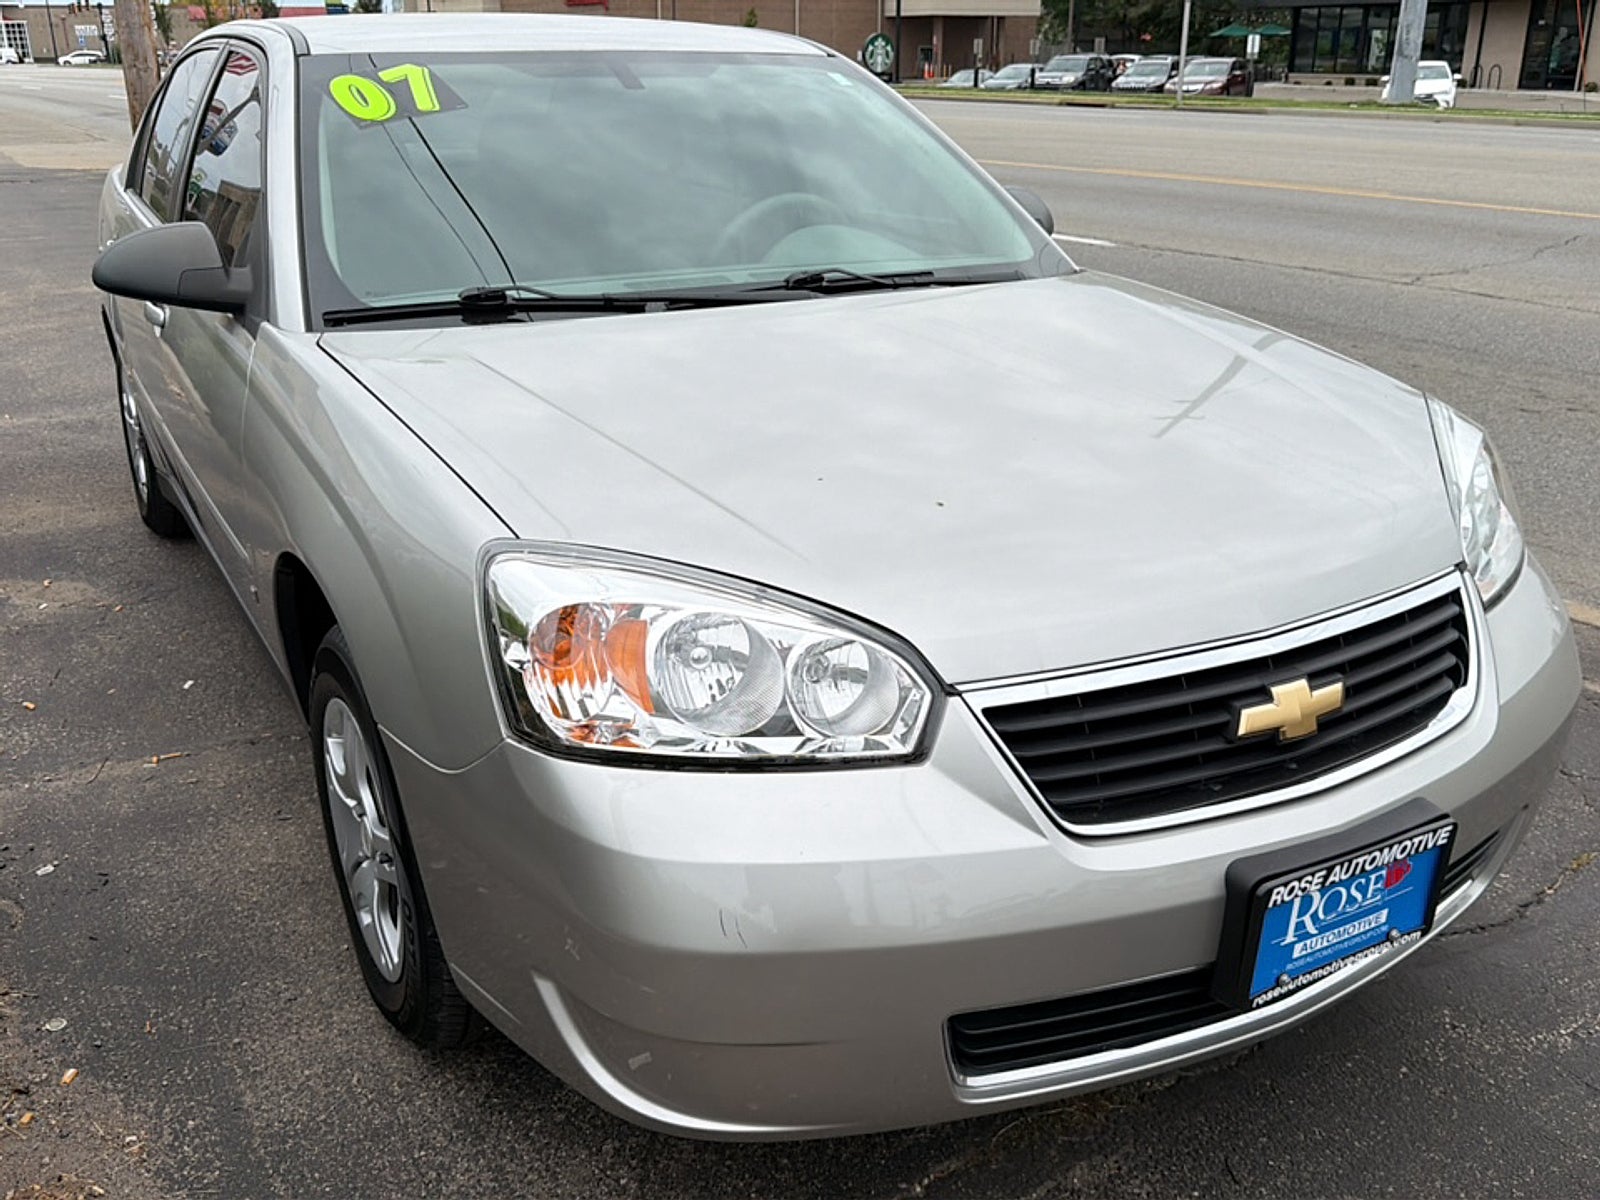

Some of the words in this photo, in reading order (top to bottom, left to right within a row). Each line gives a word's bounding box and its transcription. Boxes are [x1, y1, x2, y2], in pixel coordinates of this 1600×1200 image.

[329, 63, 440, 121] 07
[1268, 870, 1327, 908] ROSE
[1325, 825, 1453, 886] AUTOMOTIVE
[1299, 911, 1384, 955] AUTOMOTIVE
